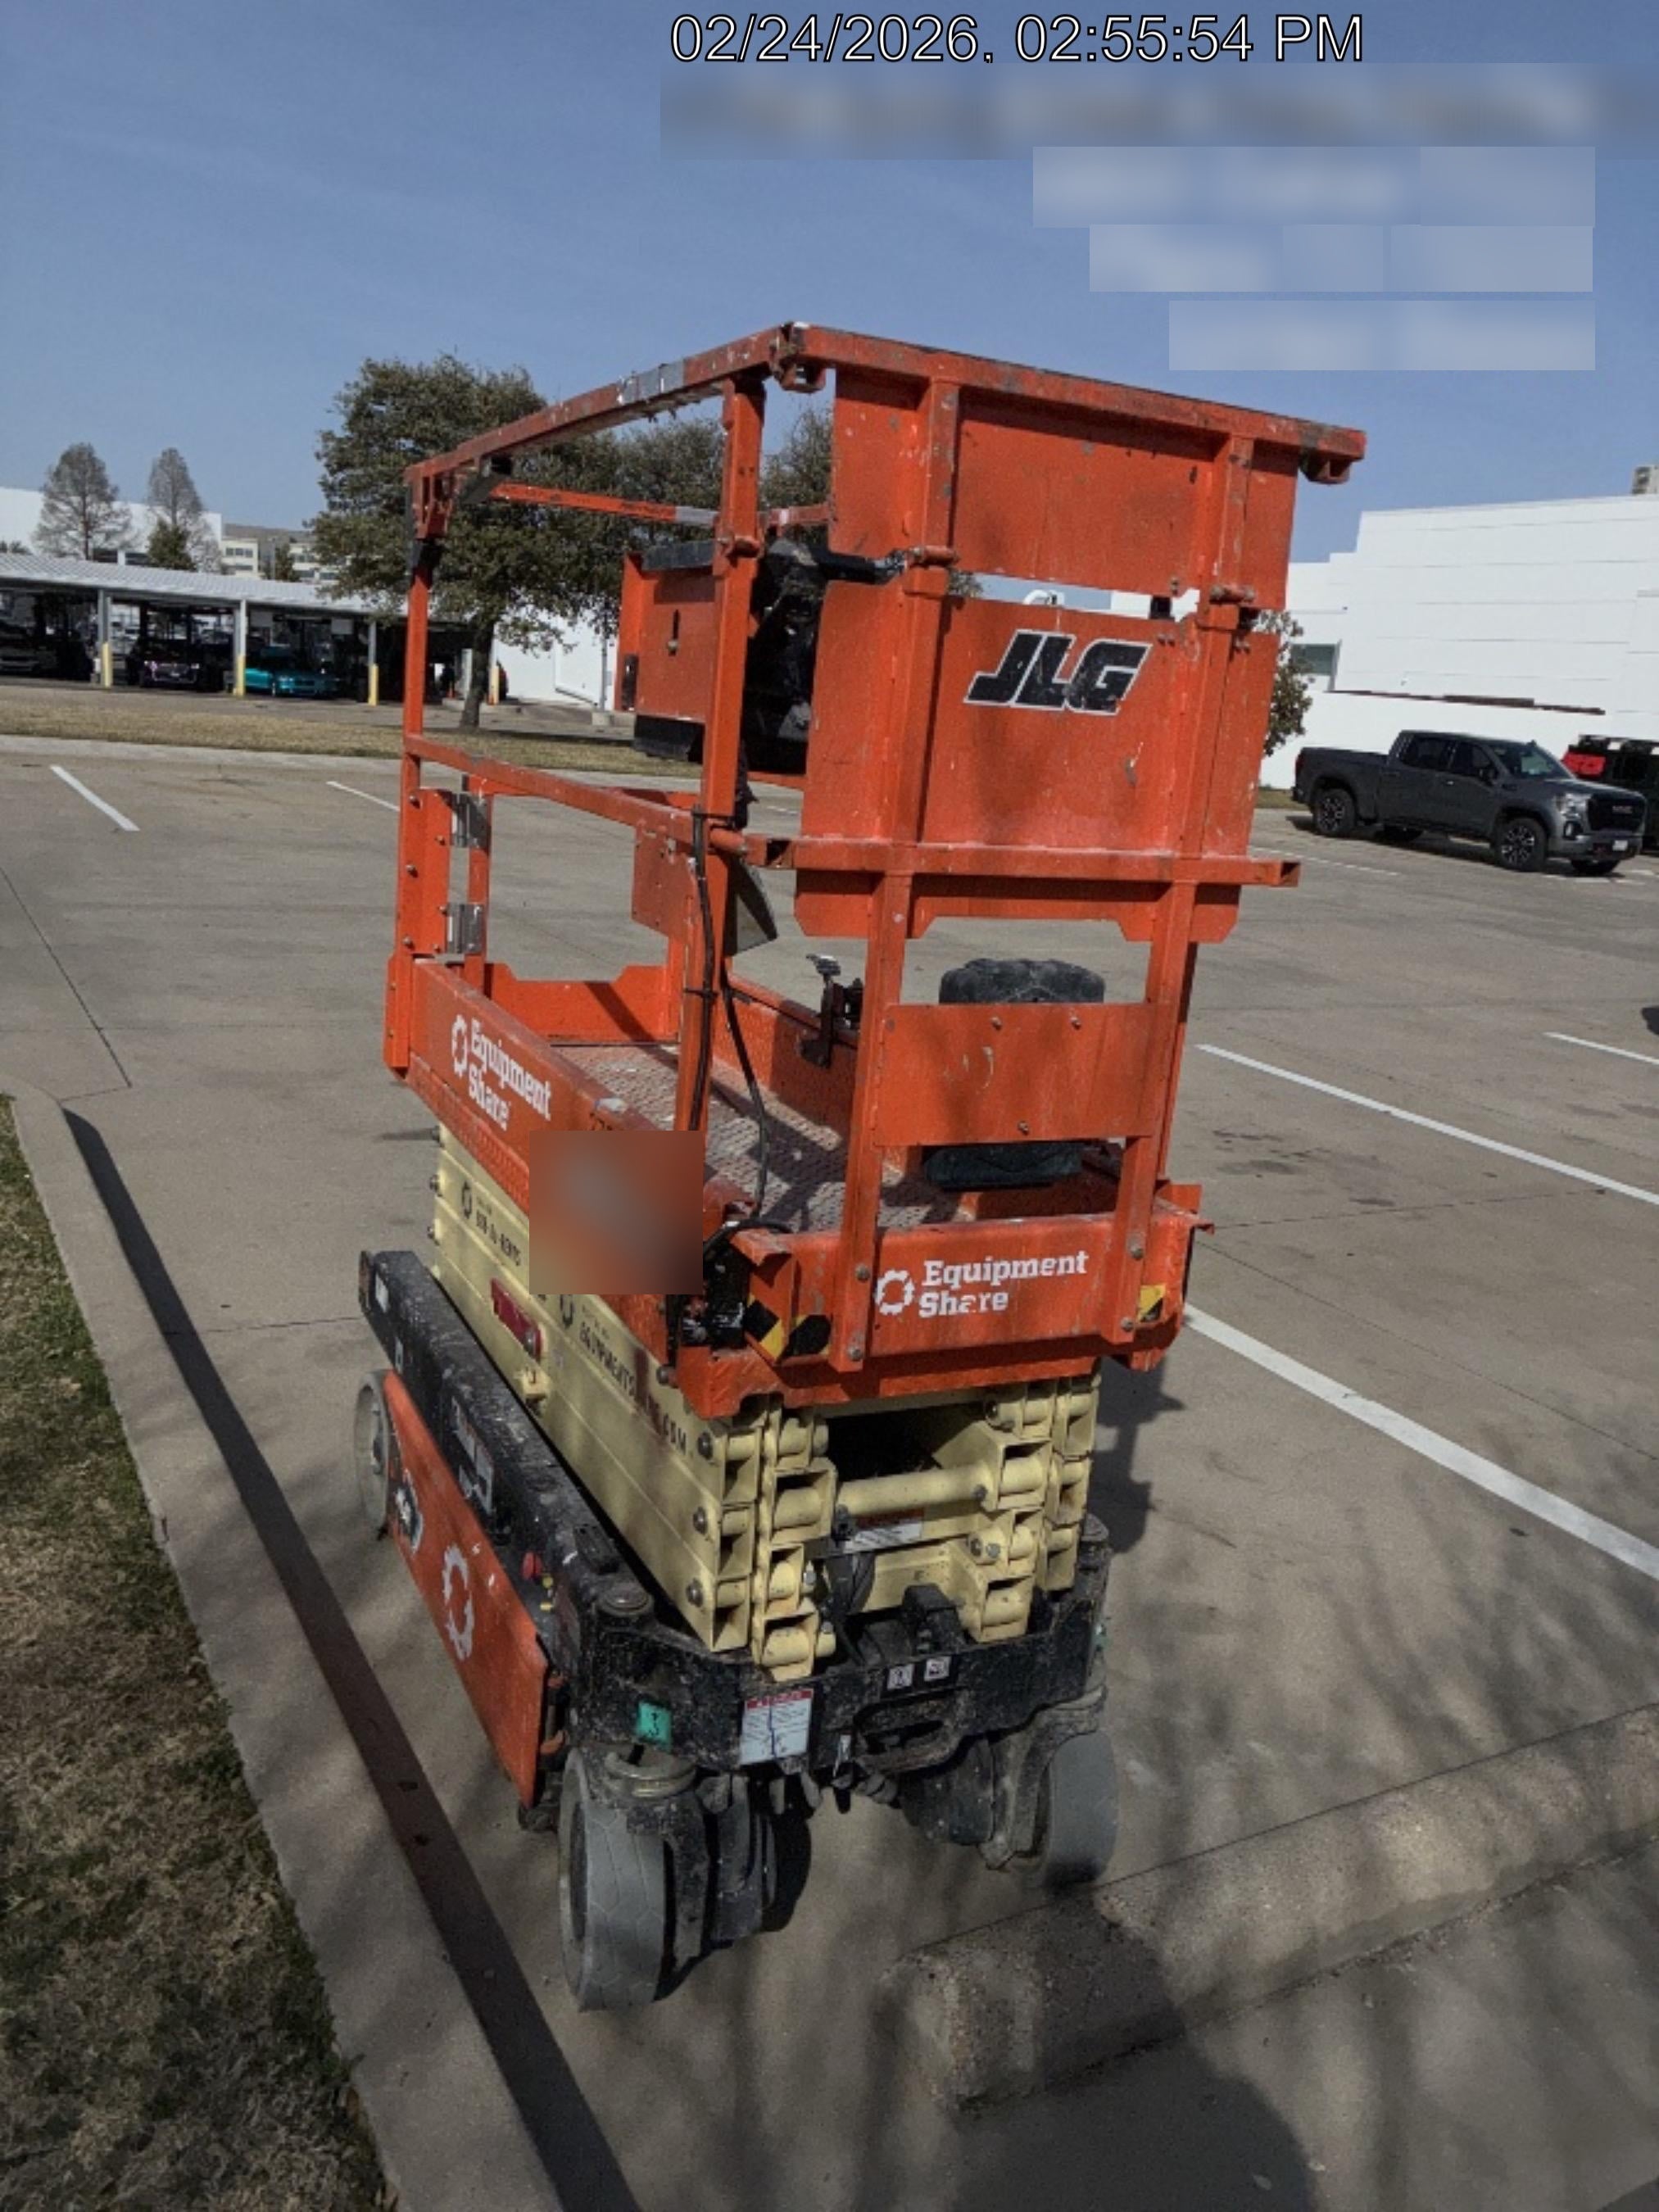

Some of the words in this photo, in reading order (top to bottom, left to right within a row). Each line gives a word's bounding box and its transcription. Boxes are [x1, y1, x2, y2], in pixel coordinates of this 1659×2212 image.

[963, 628, 1154, 715] JLG
[469, 1063, 510, 1131] Share
[471, 1018, 551, 1122] Equipment
[918, 1290, 1009, 1317] Share
[921, 1249, 1089, 1290] Equipment
